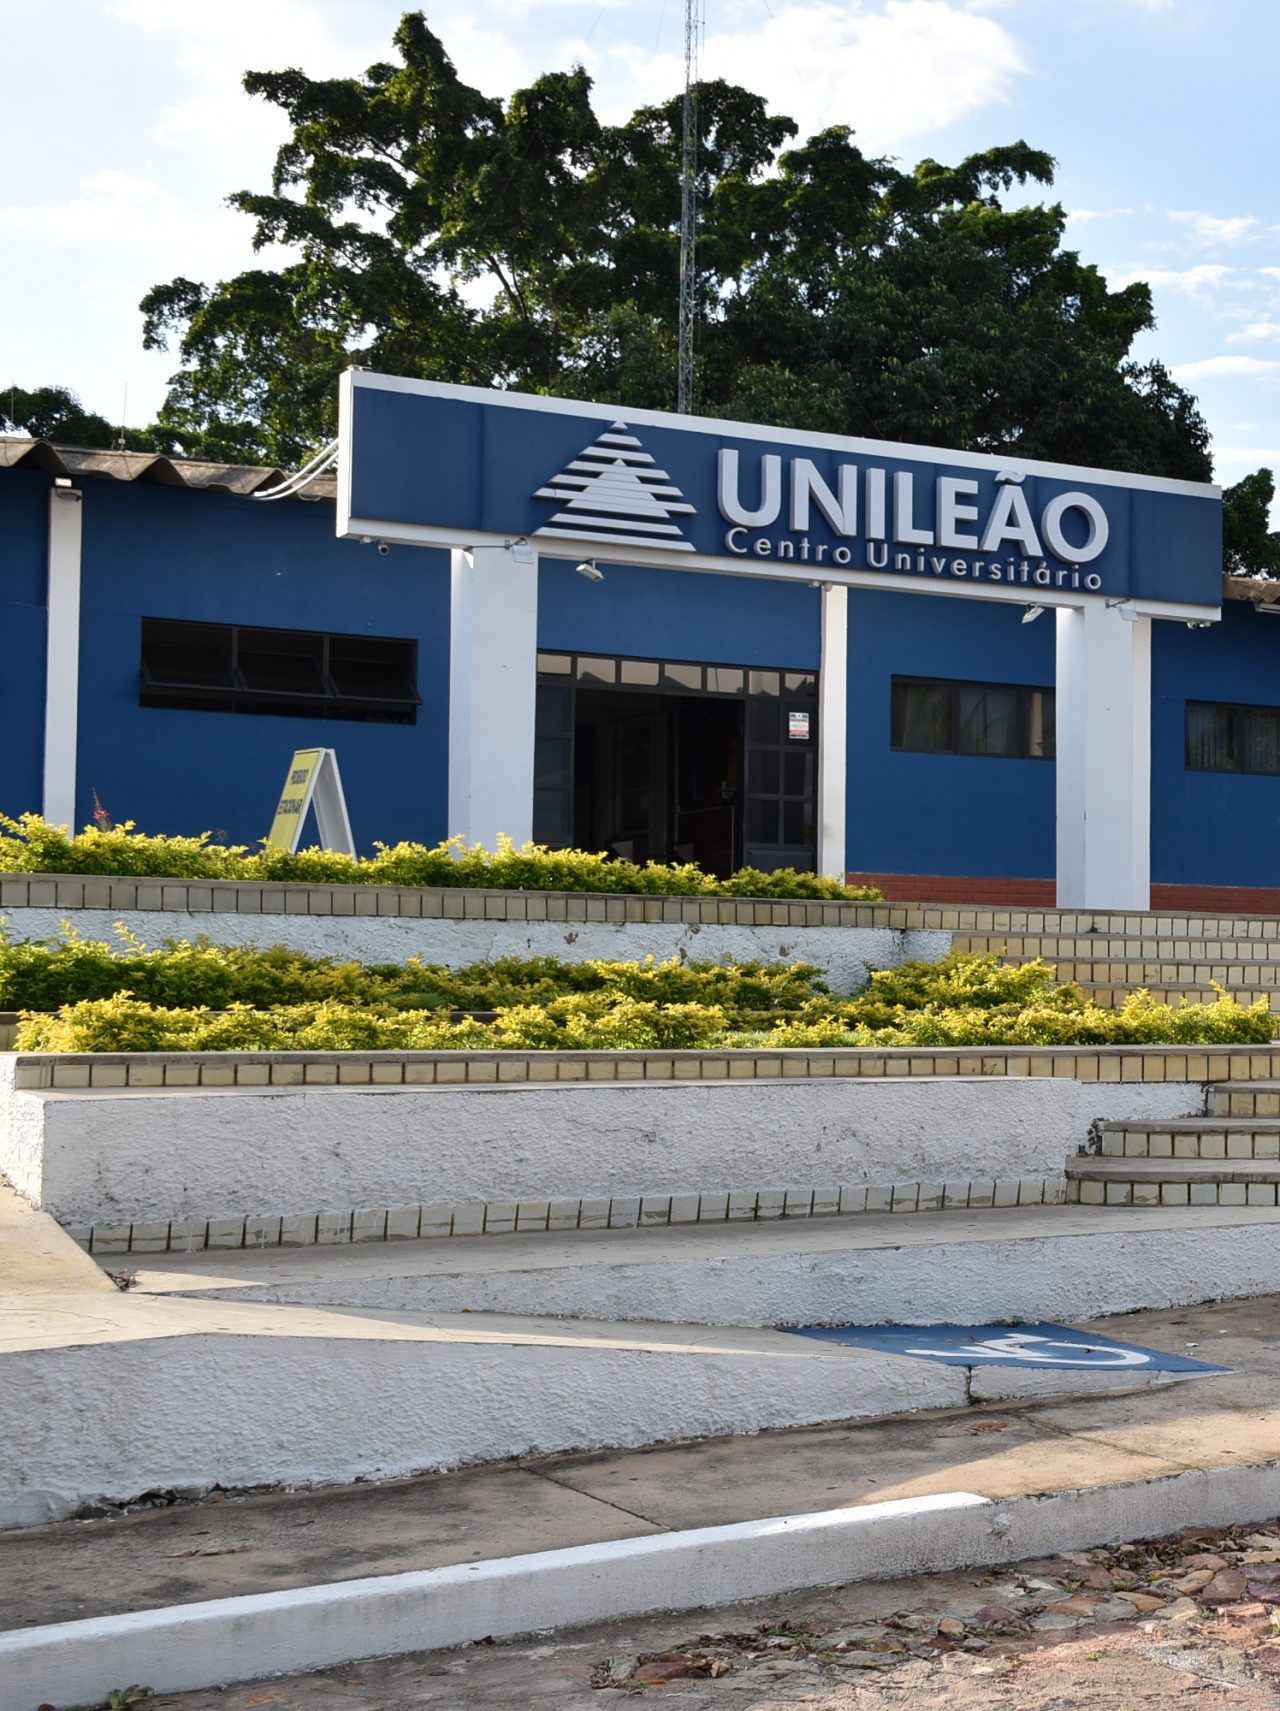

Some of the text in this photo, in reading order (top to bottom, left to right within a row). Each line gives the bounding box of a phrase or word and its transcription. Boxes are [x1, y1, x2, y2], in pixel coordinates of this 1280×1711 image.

[717, 448, 1109, 563] UNILEÃO
[725, 527, 1102, 590] Centro Universitário
